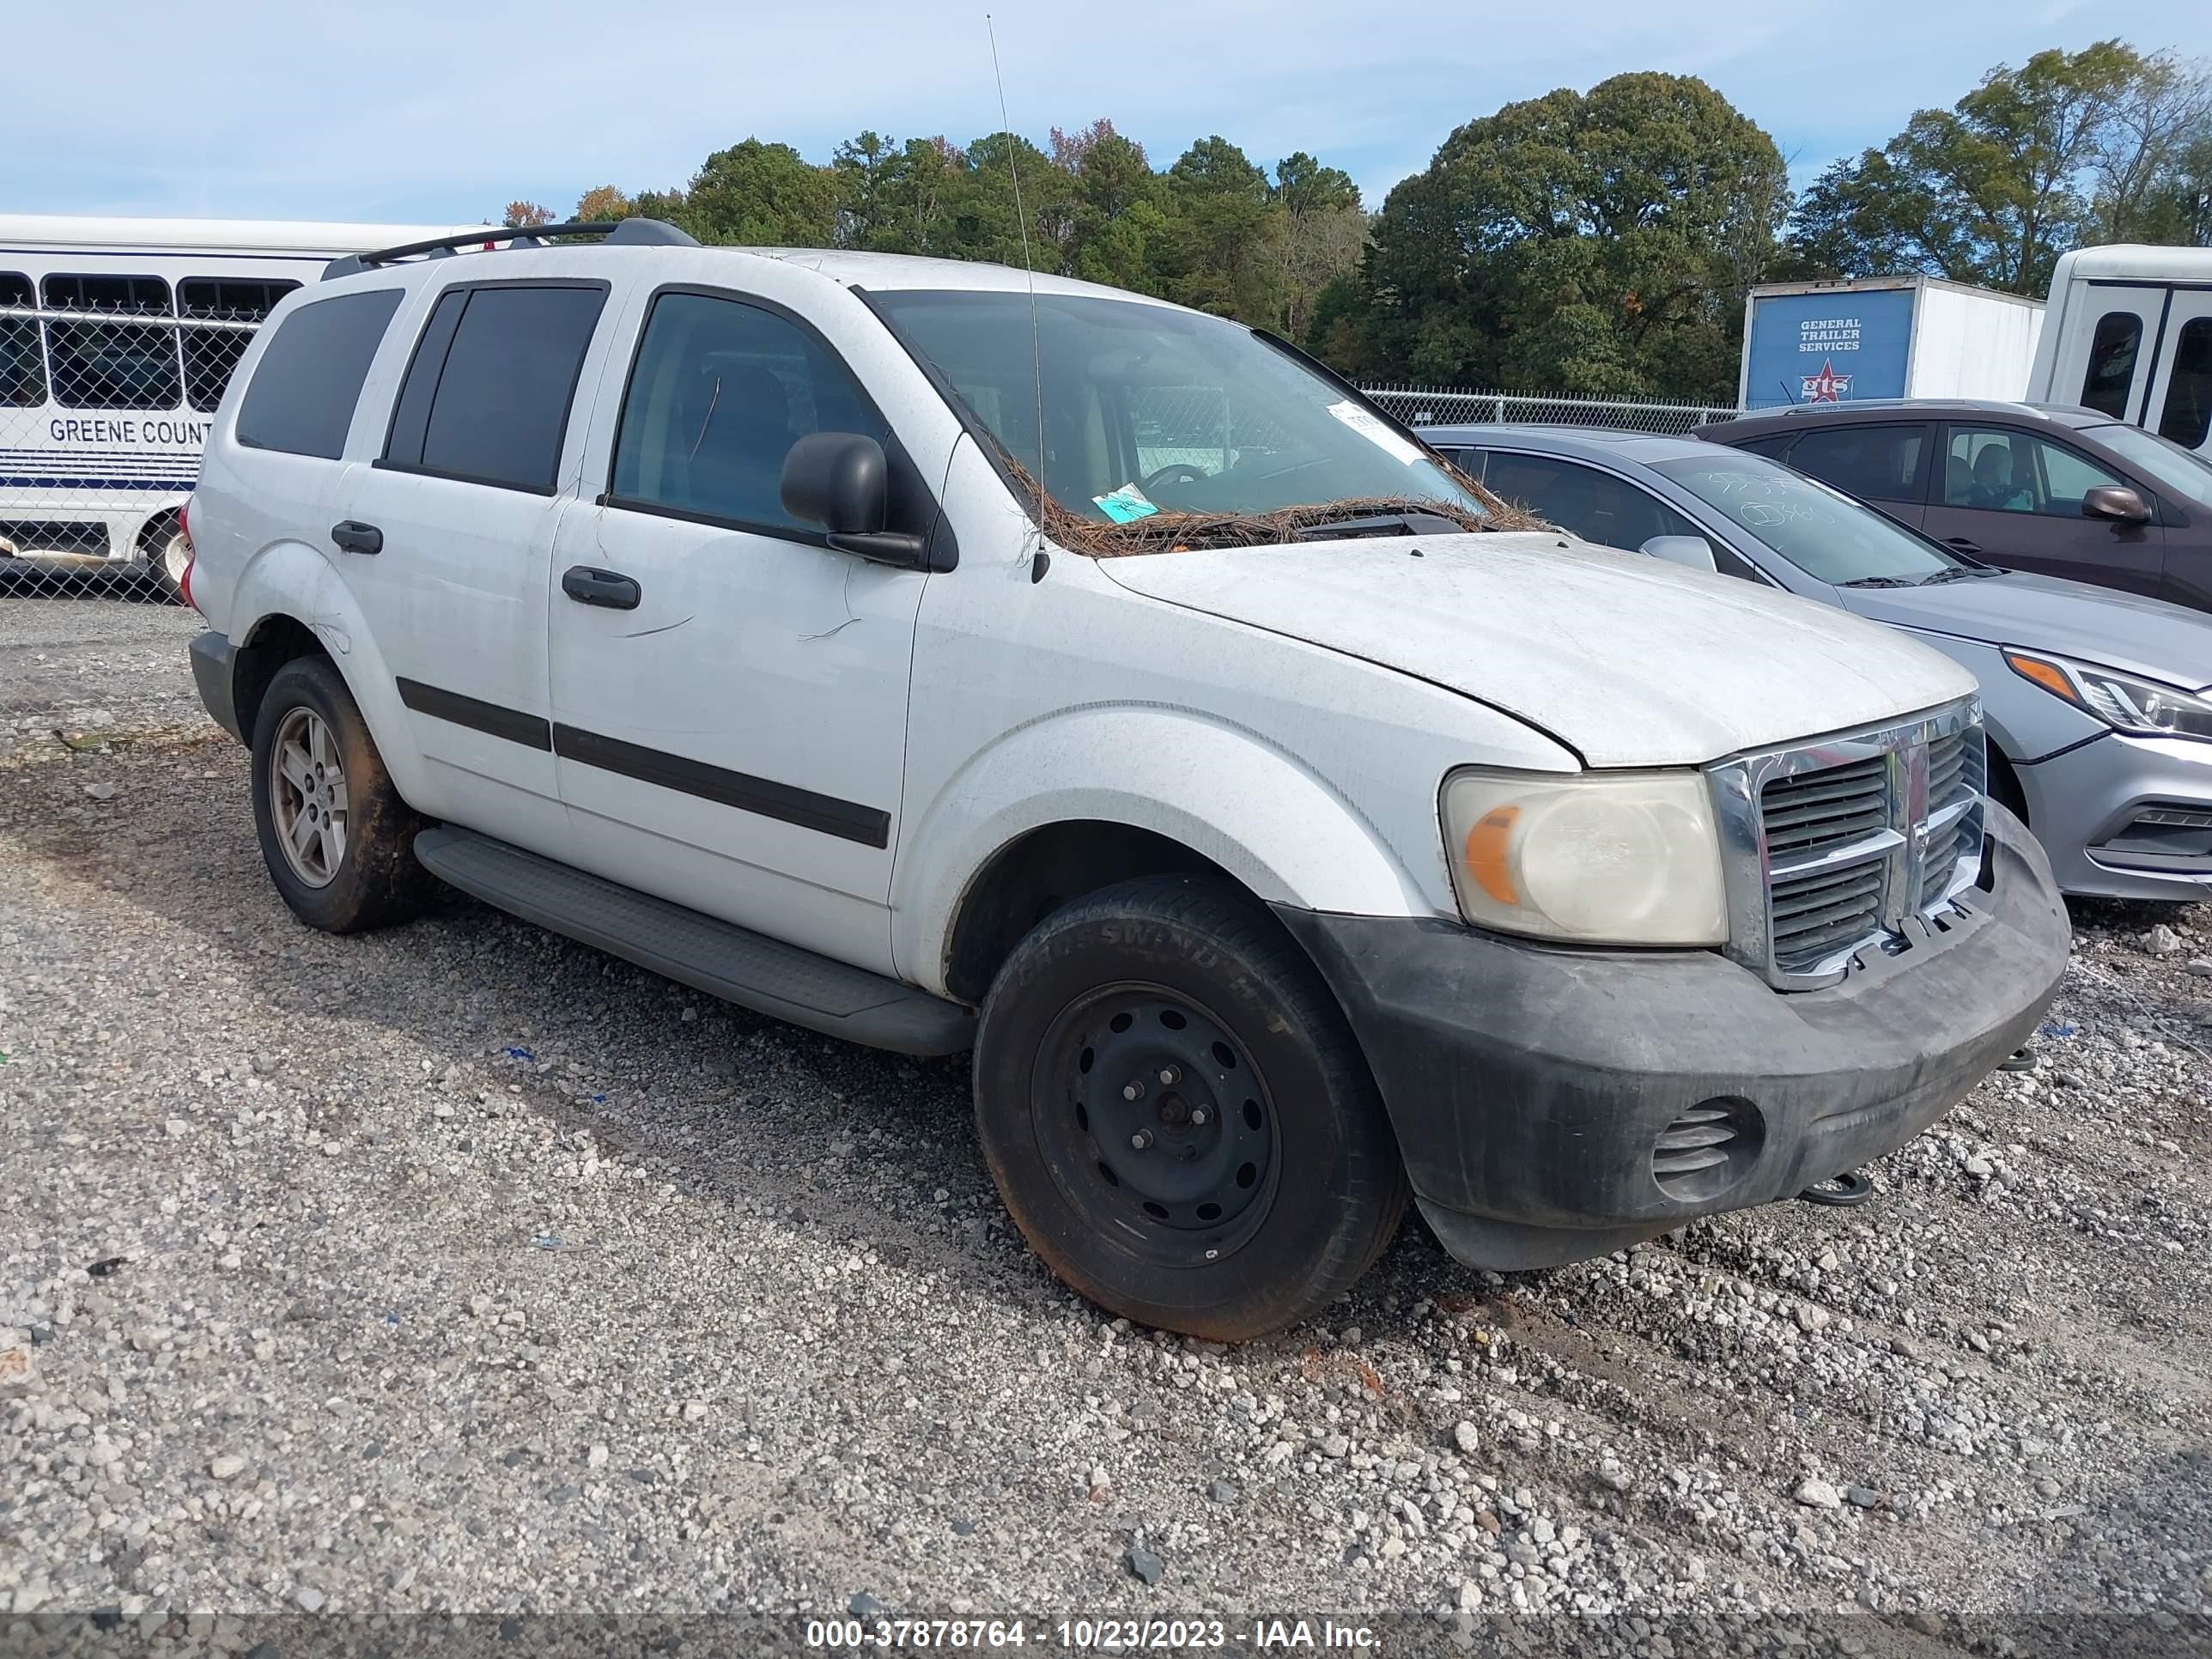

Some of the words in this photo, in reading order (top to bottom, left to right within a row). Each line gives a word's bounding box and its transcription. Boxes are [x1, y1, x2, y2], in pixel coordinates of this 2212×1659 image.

[1801, 319, 1862, 330] GENERAL
[1801, 330, 1860, 341] TRAILER
[1799, 341, 1860, 352] SERVICES
[50, 419, 137, 443] GREENE
